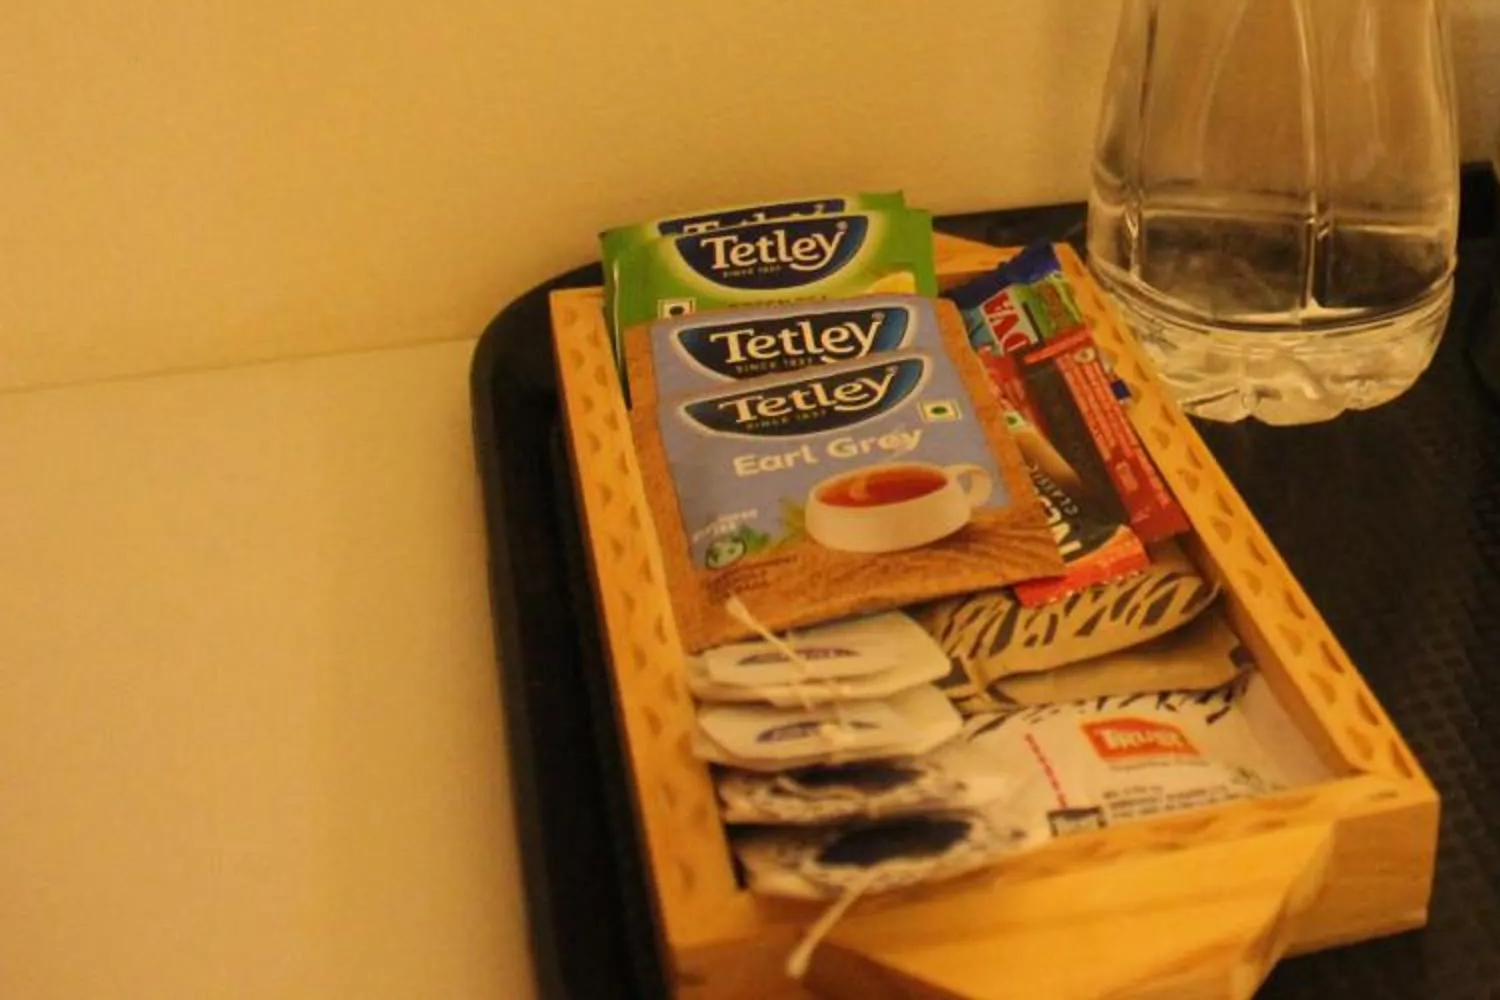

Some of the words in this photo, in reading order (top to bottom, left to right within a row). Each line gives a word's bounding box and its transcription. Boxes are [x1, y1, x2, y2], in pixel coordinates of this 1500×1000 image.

[700, 229, 847, 272] Tetley
[709, 318, 883, 365] Tetley
[718, 371, 896, 424] Tetley
[732, 445, 820, 478] Earl
[825, 428, 923, 459] Grey
